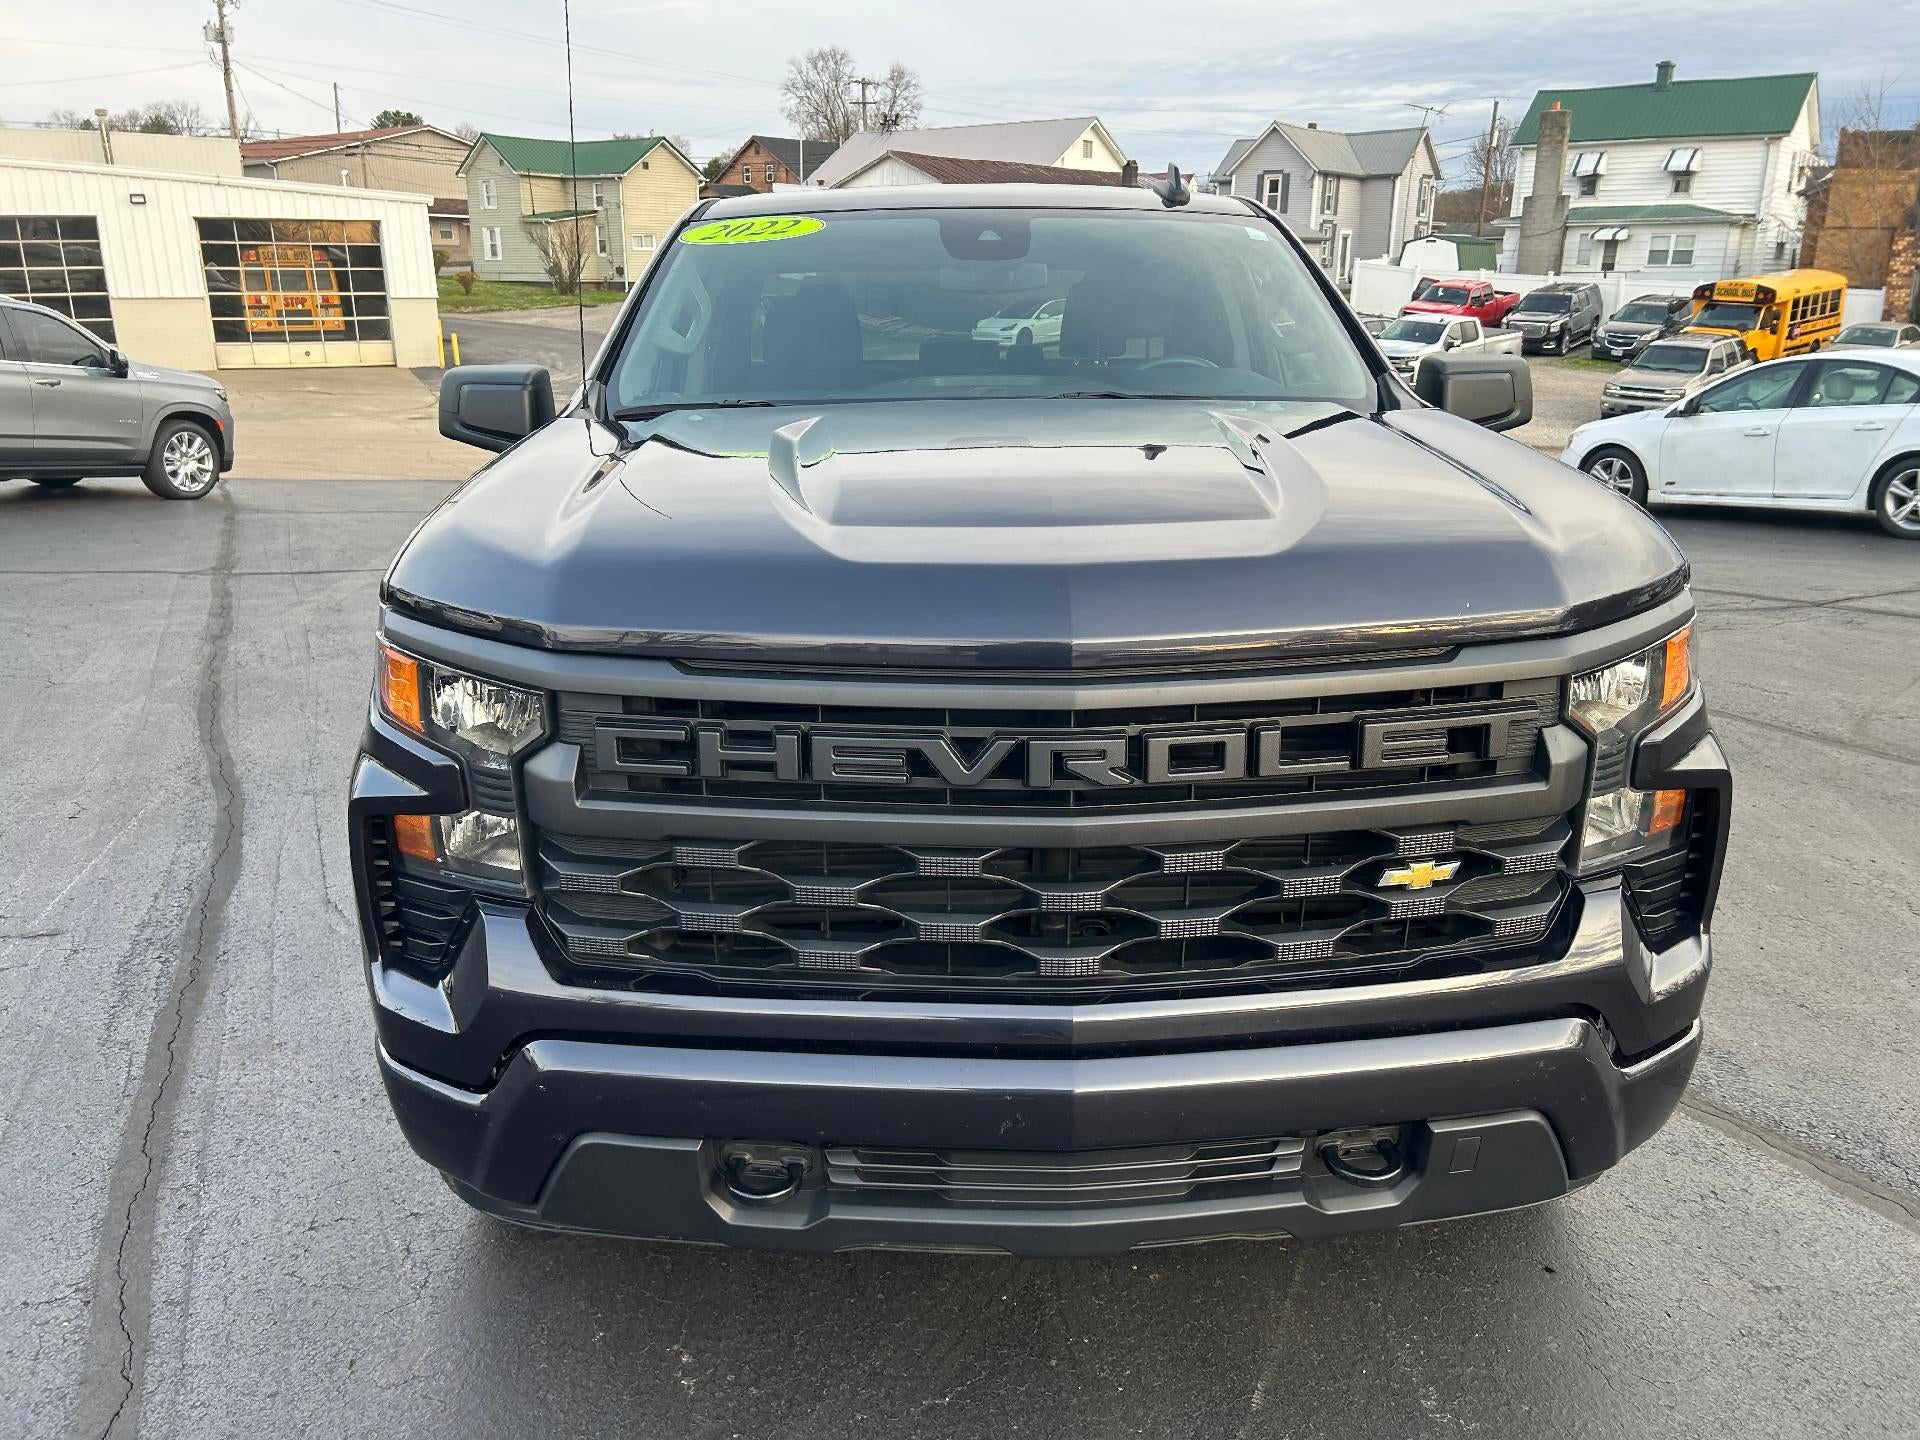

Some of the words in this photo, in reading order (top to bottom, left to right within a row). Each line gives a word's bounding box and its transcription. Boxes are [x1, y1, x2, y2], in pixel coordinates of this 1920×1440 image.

[699, 219, 802, 241] 2022
[262, 250, 290, 260] SCHOOL
[294, 250, 309, 260] BUS
[1715, 287, 1739, 297] SCHOOL
[1741, 288, 1755, 297] BUS
[283, 296, 308, 308] STOP
[594, 700, 1540, 788] CHEVROLET
